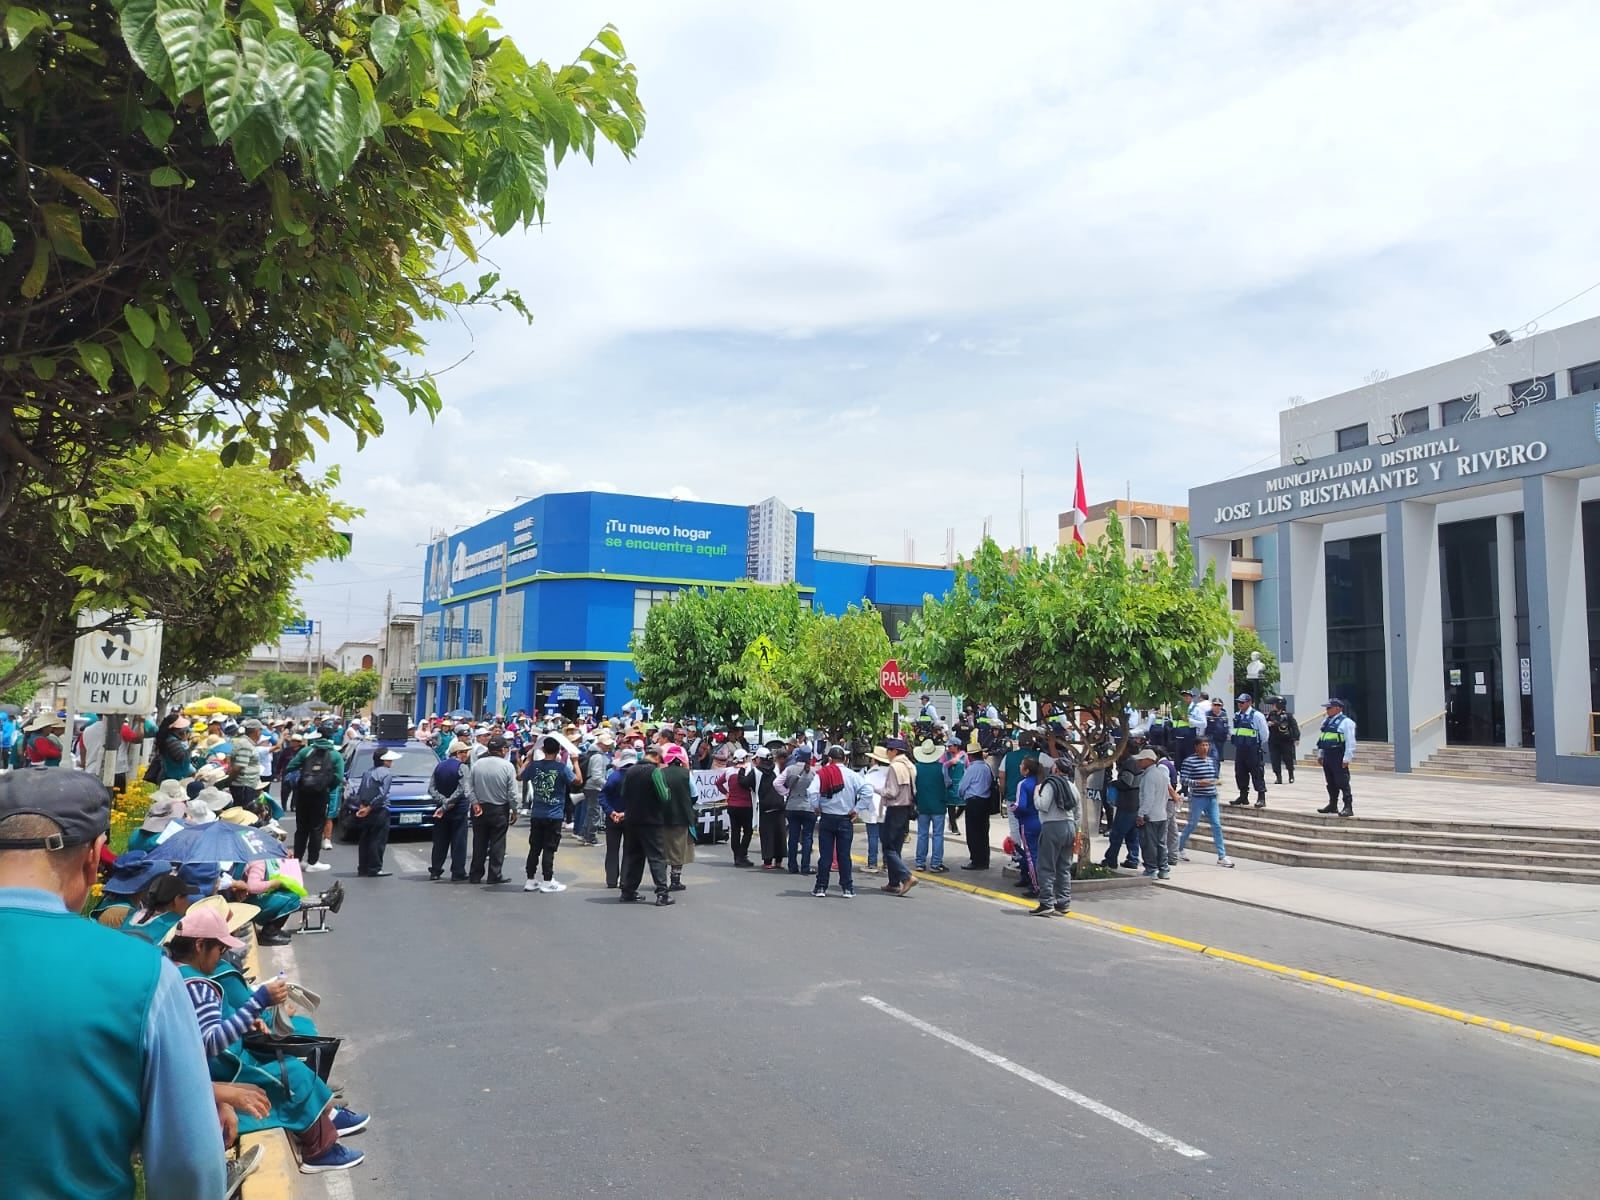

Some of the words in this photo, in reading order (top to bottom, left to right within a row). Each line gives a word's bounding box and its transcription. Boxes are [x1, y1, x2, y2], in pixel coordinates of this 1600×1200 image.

[1265, 457, 1372, 493] MUNICIPALIDAD
[1381, 437, 1460, 468] DISTRITAL
[1214, 502, 1251, 524] JOSE
[1257, 494, 1293, 516] LUIS
[1300, 467, 1419, 508] BUSTAMANTE
[1429, 461, 1443, 481] Y
[1457, 441, 1548, 476] RIVERO
[629, 523, 670, 536] nuevo
[673, 525, 711, 542] hogar
[605, 537, 622, 547] se
[625, 538, 693, 553] encuentra
[83, 671, 99, 685] NO
[101, 672, 148, 687] VOLTEAR
[882, 671, 908, 687] PAR
[91, 689, 110, 703] EN
[123, 689, 138, 705] U
[700, 788, 720, 799] NCA
[1087, 789, 1102, 801] CIA
